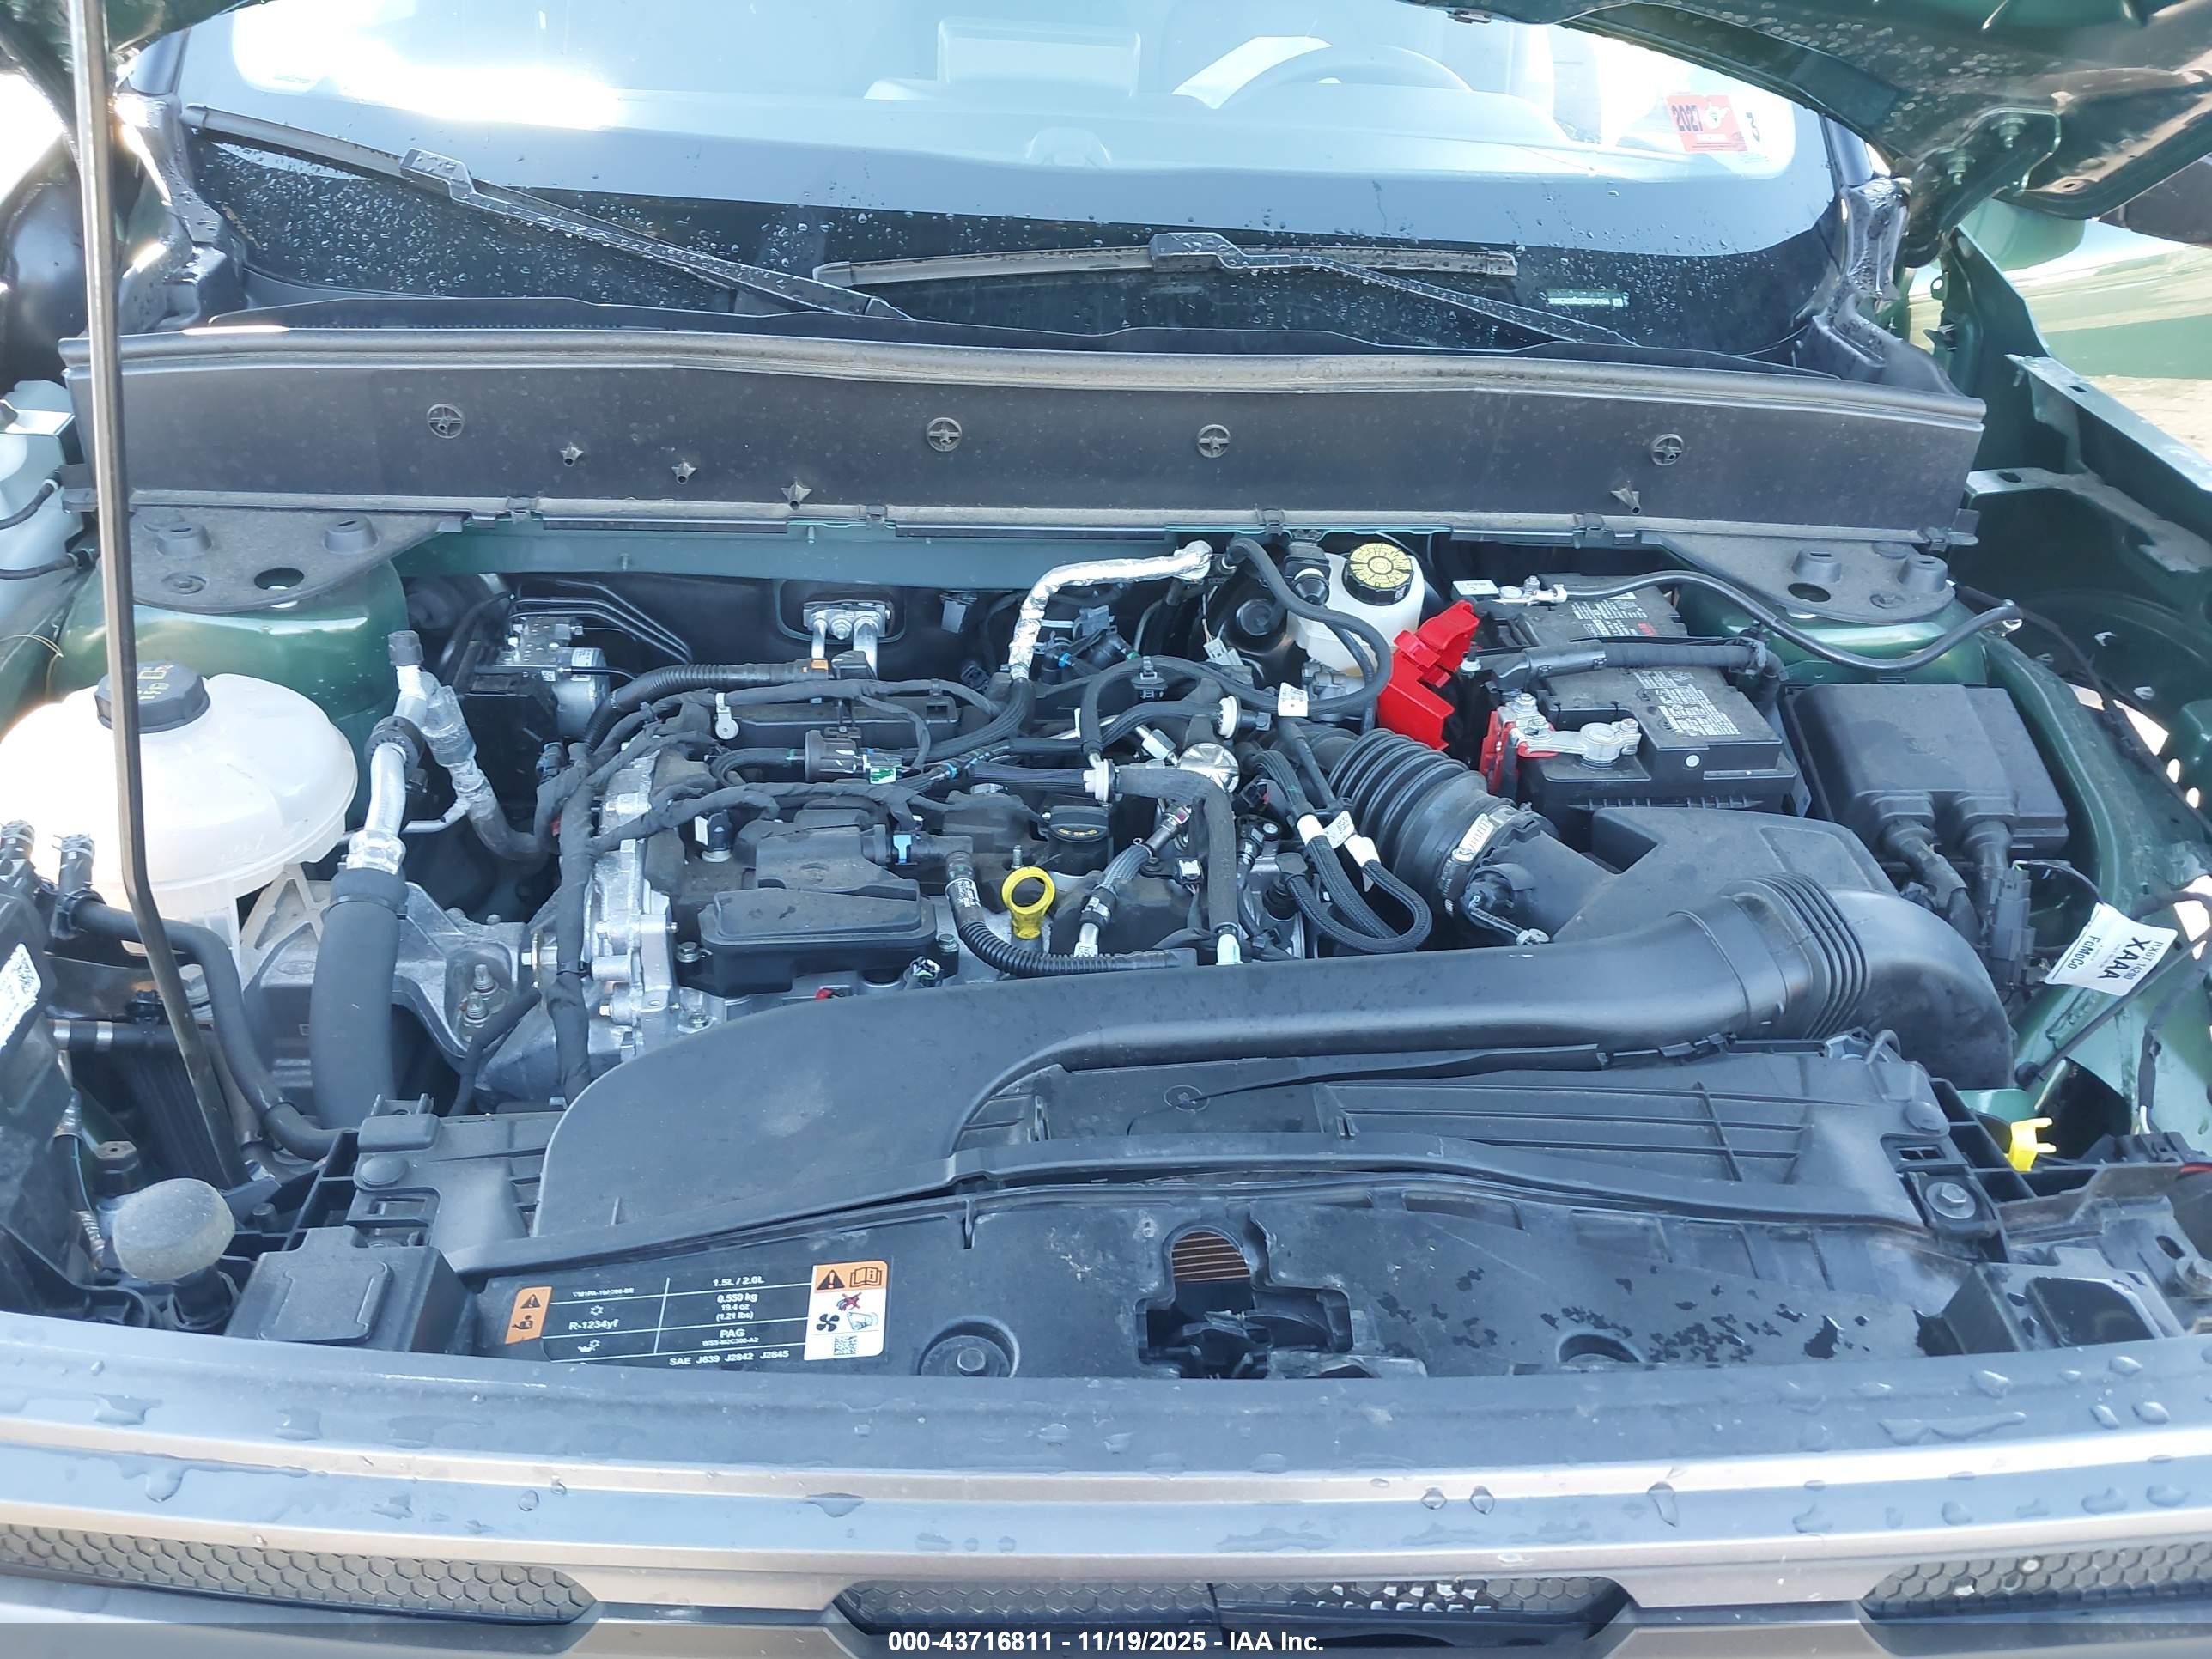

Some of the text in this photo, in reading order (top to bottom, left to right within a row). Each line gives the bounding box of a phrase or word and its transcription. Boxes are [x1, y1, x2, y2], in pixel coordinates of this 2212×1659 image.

[1671, 105, 1704, 132] 2027
[2067, 935, 2102, 970] FoMoCo
[2097, 936, 2152, 980] XAAA
[713, 1279, 734, 1287] 1.5L
[742, 1275, 765, 1285] 2.0L
[716, 1292, 758, 1304] 0.550 kg
[715, 1311, 754, 1322] (1.21 lbs)
[568, 1319, 619, 1330] R-1234yf
[719, 1328, 745, 1338] PAG
[669, 1350, 789, 1366] SAE J639 J2842 J2845
